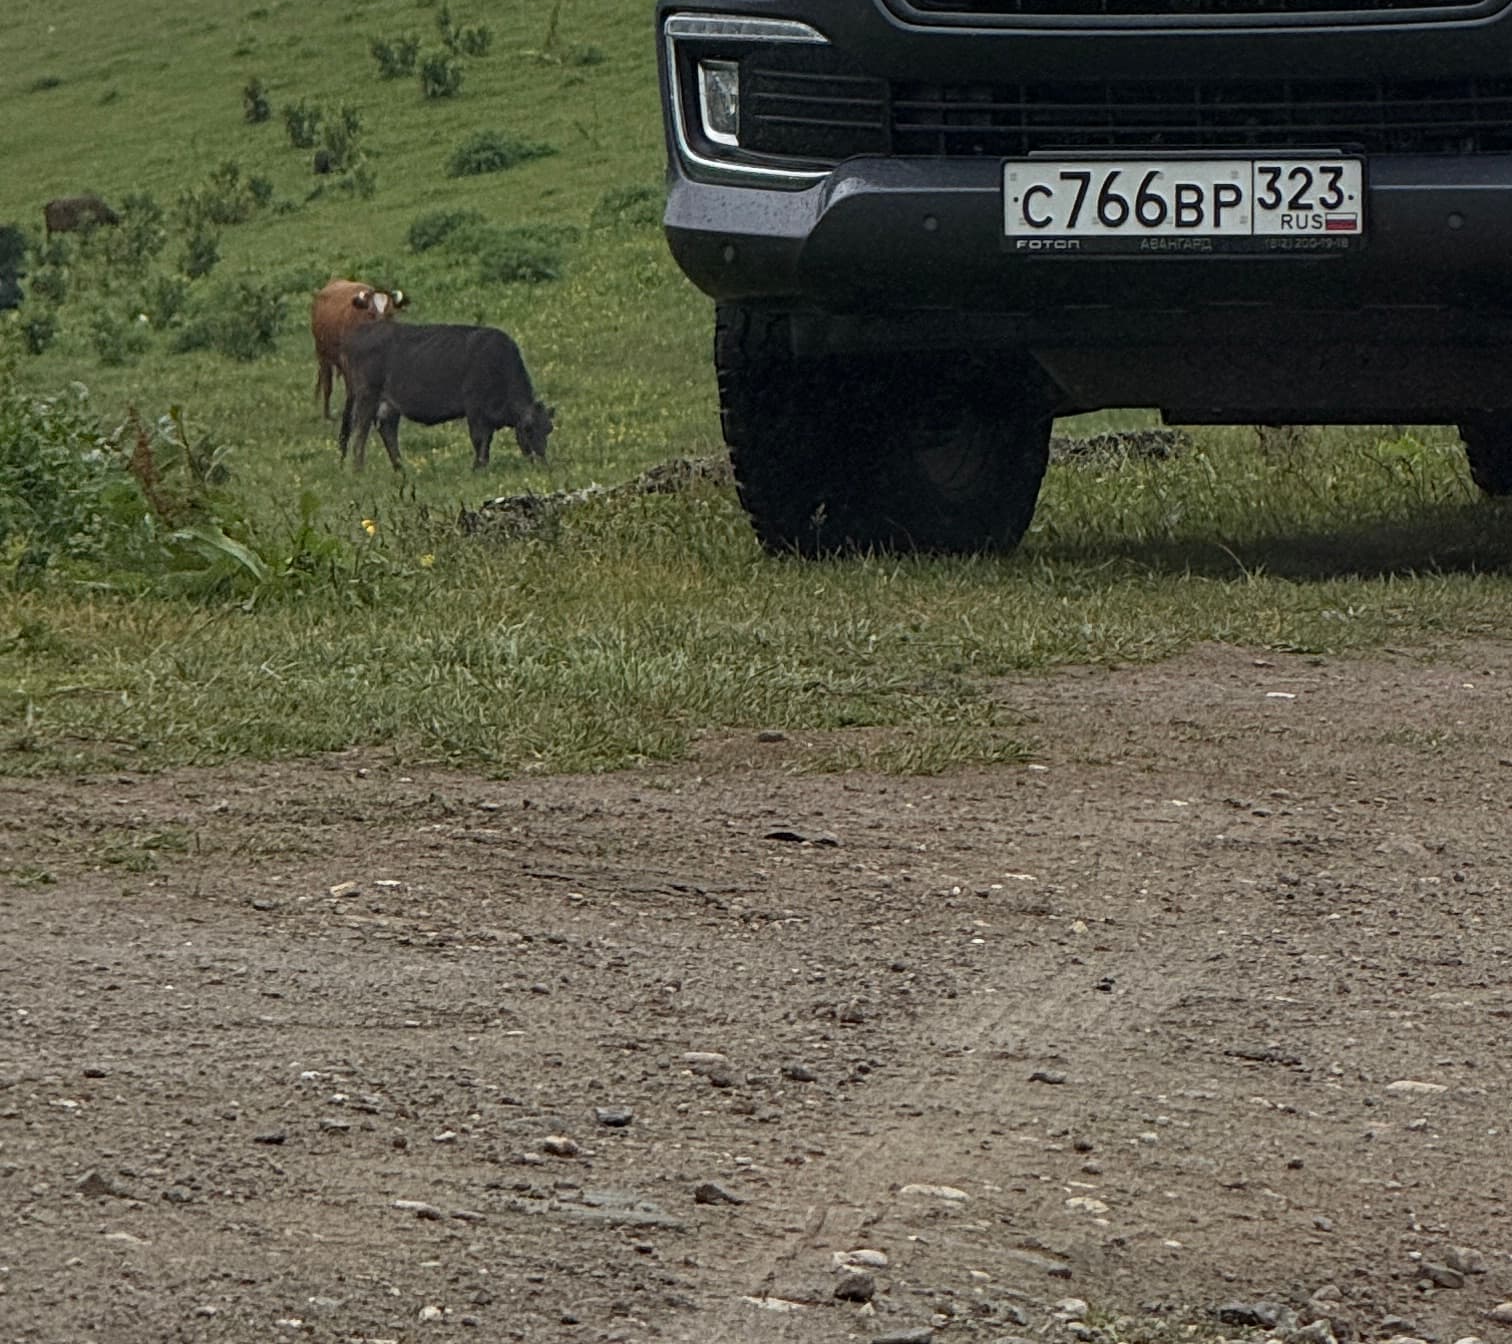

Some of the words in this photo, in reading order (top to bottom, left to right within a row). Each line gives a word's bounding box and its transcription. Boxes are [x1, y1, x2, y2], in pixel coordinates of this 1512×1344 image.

[1257, 166, 1344, 211] 323
[1280, 213, 1323, 230] RUS
[1140, 238, 1213, 252] АВАНГАРД
